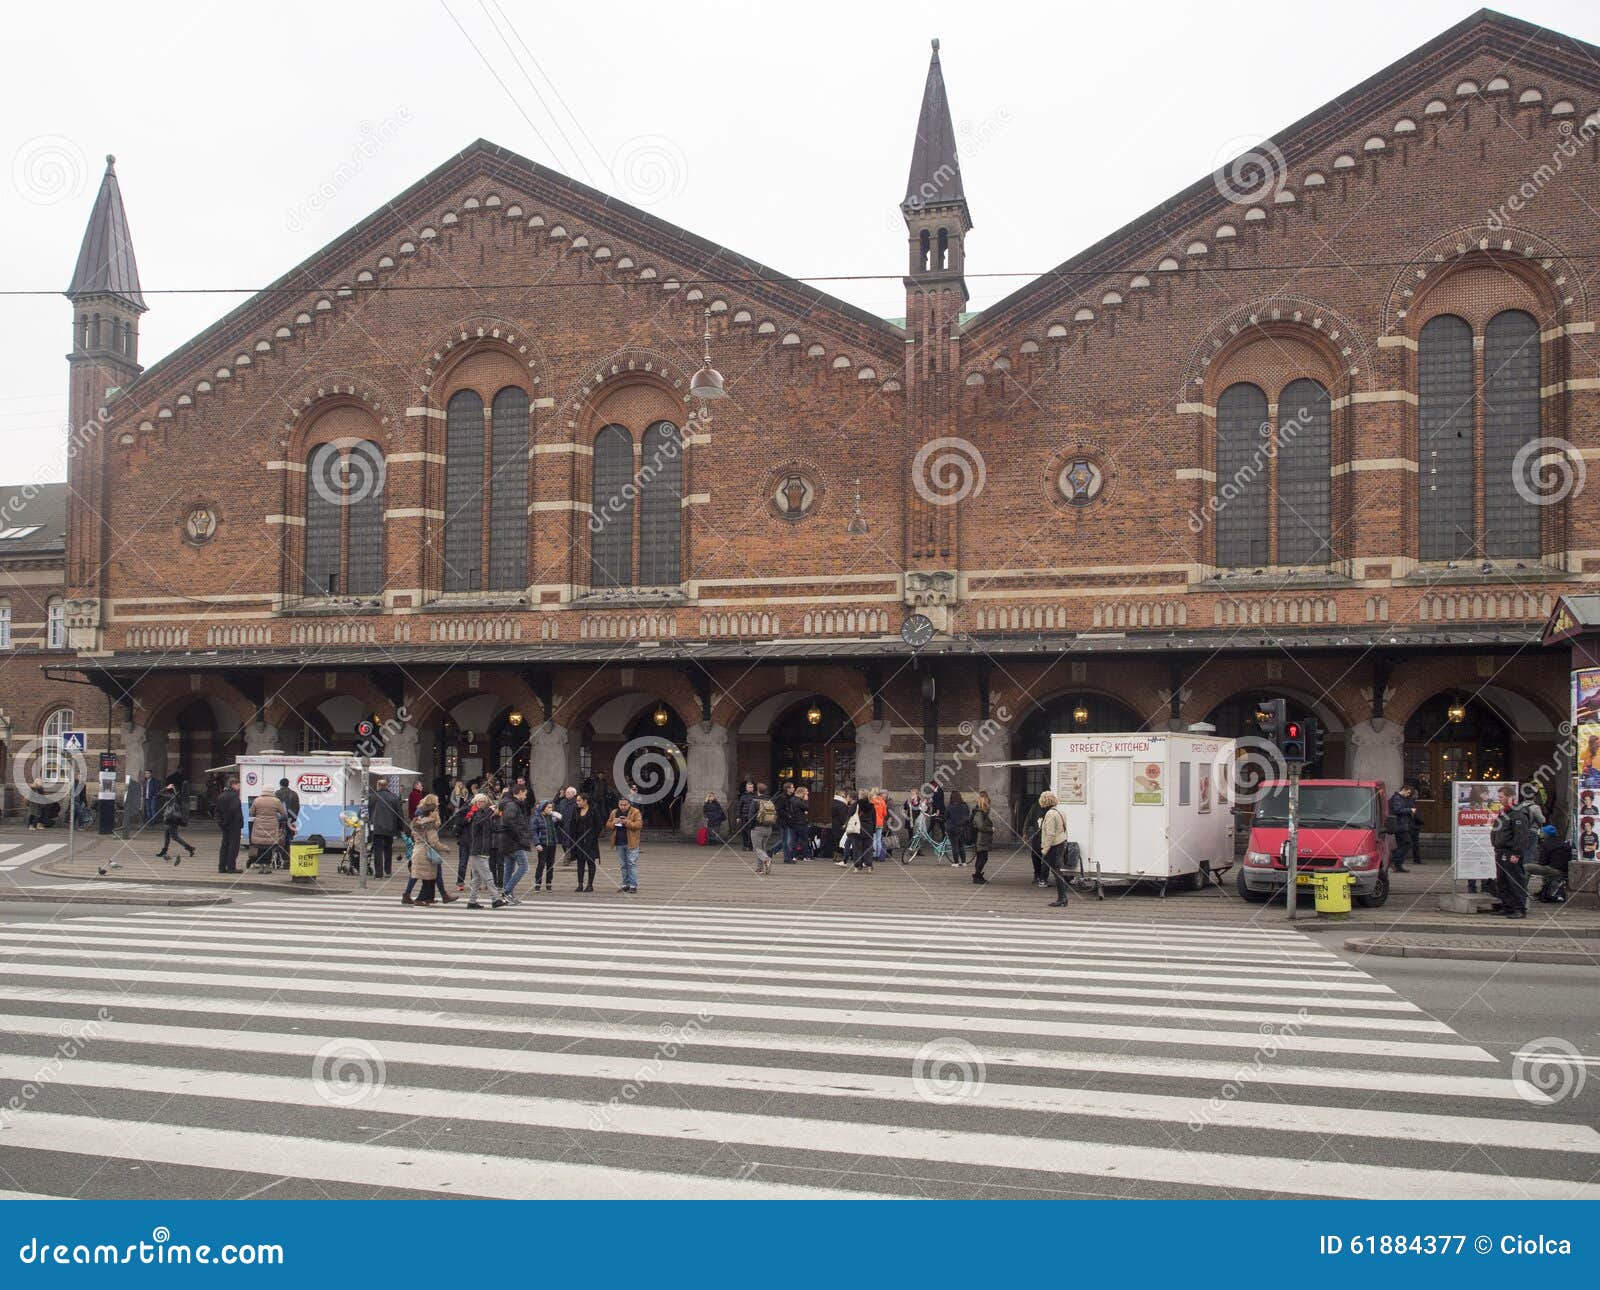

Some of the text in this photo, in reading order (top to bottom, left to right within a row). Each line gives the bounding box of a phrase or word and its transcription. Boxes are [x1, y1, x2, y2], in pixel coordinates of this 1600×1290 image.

[1069, 742, 1149, 753] STREET KITCHEN
[302, 775, 328, 786] STEFF
